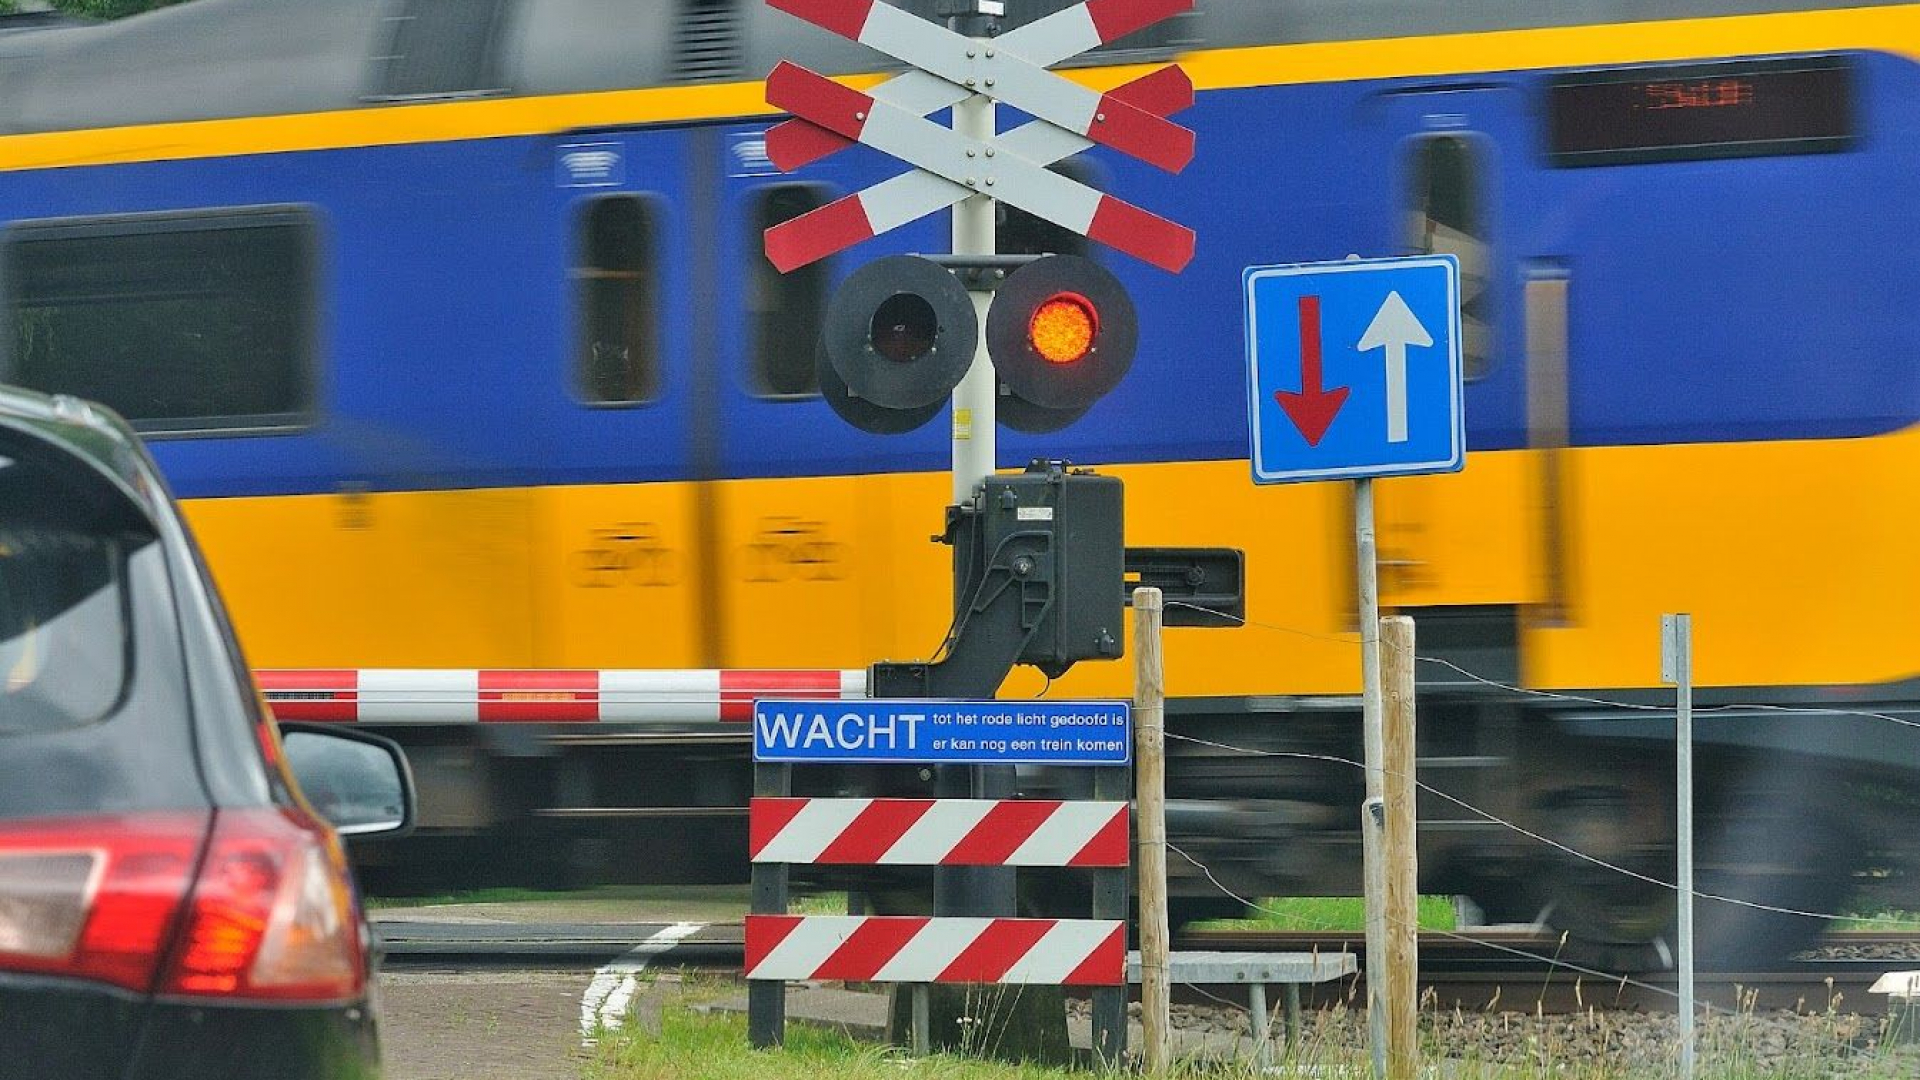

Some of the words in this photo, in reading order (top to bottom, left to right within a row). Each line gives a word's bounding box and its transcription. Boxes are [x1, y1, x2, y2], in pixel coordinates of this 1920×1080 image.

[933, 713, 951, 725] tot
[956, 713, 977, 725] het
[981, 713, 1012, 725] rode
[1017, 713, 1046, 725] licht
[1050, 713, 1107, 728] gedoofd
[1111, 713, 1124, 725] is
[757, 713, 926, 749] WACHT
[933, 740, 947, 750] er
[950, 738, 975, 750] kan
[980, 740, 1006, 753] nog
[1010, 740, 1036, 750] een
[1040, 738, 1071, 750] trein
[1077, 738, 1124, 750] komen
